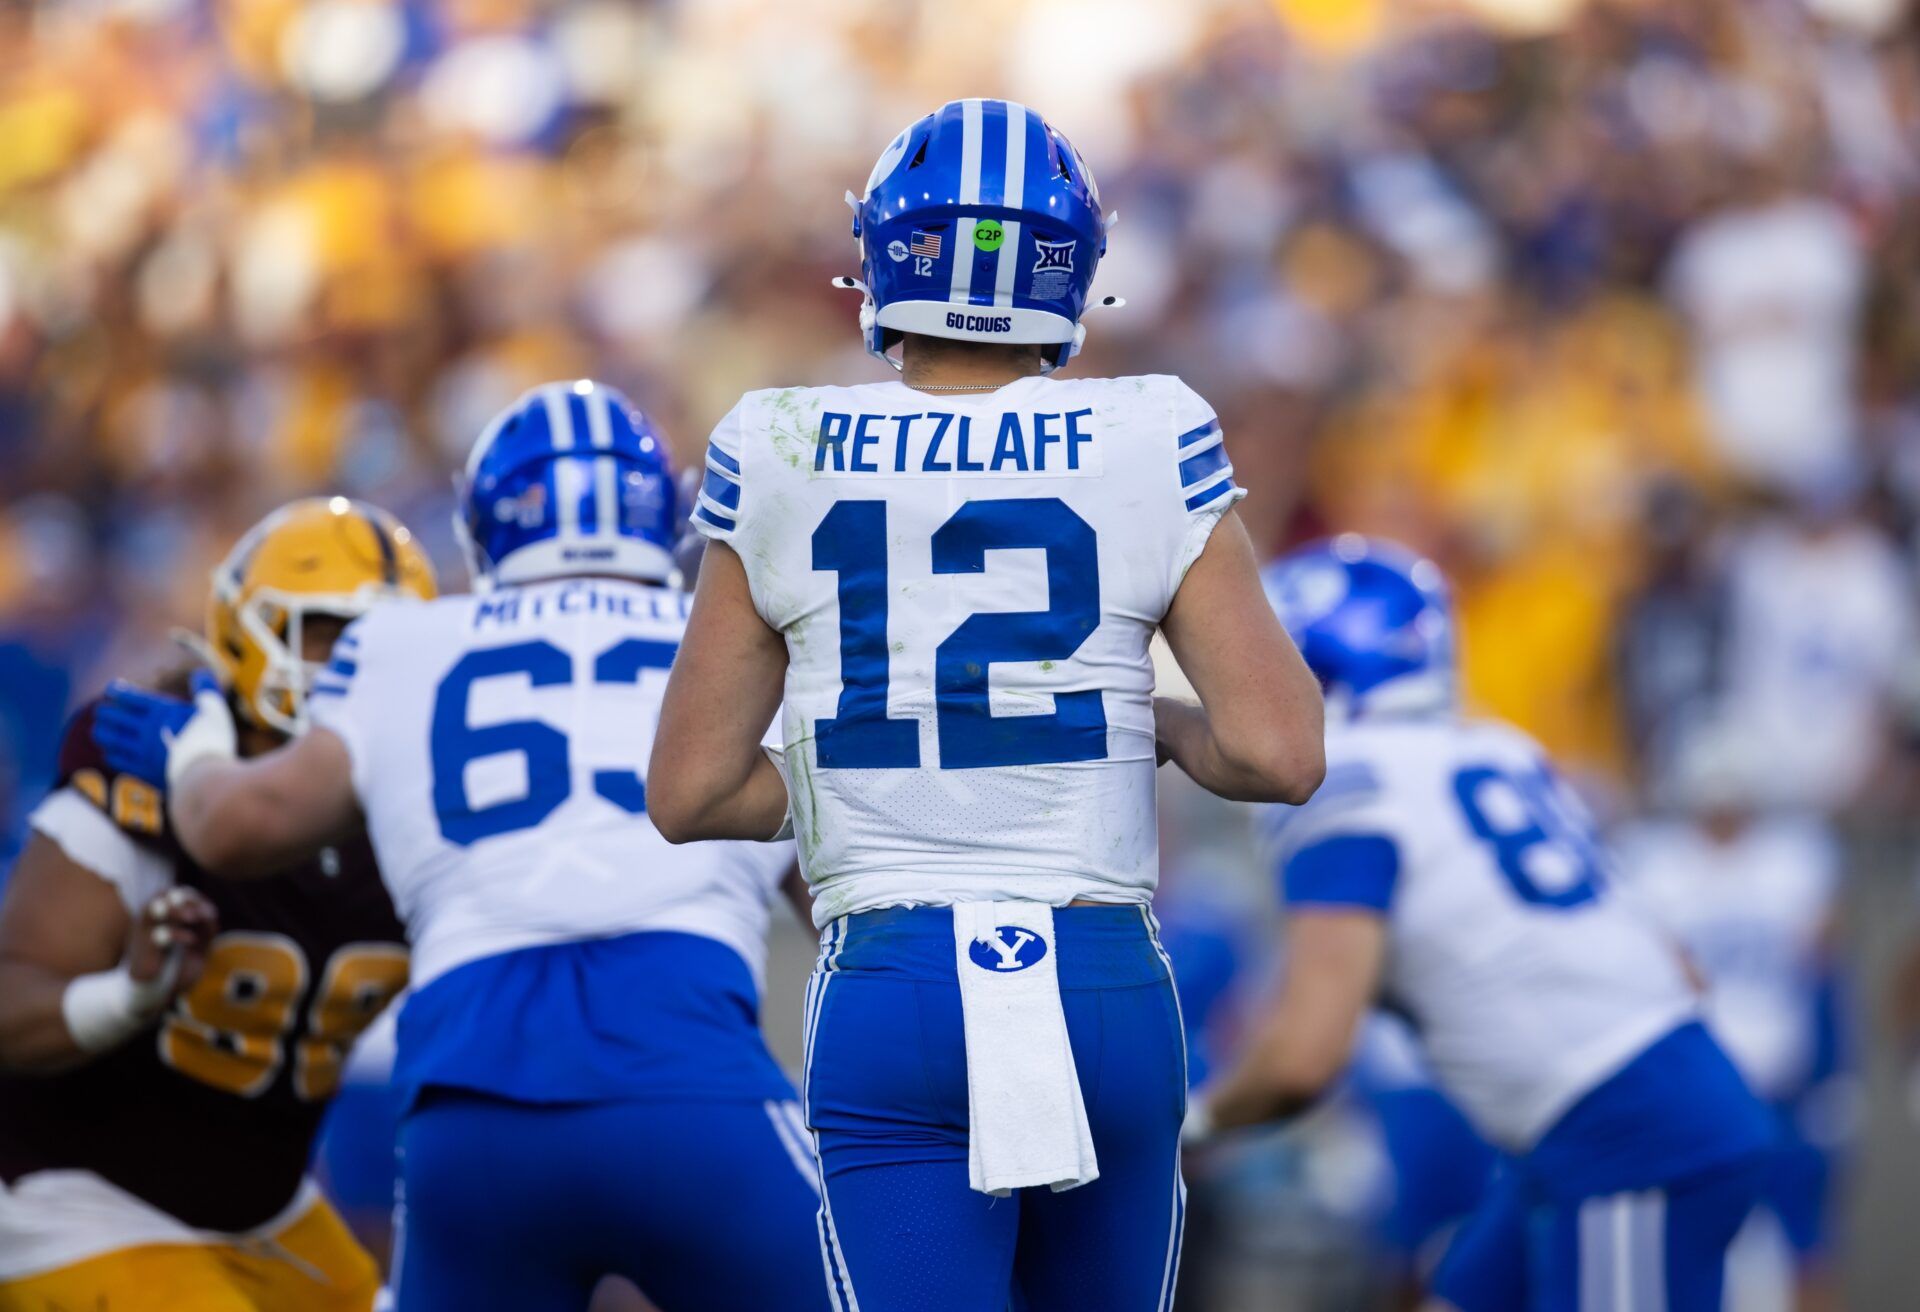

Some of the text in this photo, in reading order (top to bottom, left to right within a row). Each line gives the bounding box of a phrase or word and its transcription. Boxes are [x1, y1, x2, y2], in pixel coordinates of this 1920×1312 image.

[975, 229, 1002, 241] C2P
[914, 256, 933, 277] 12
[946, 312, 1012, 332] GO COUGS
[813, 407, 1093, 472] RETZLAFF
[811, 497, 1109, 770] 12
